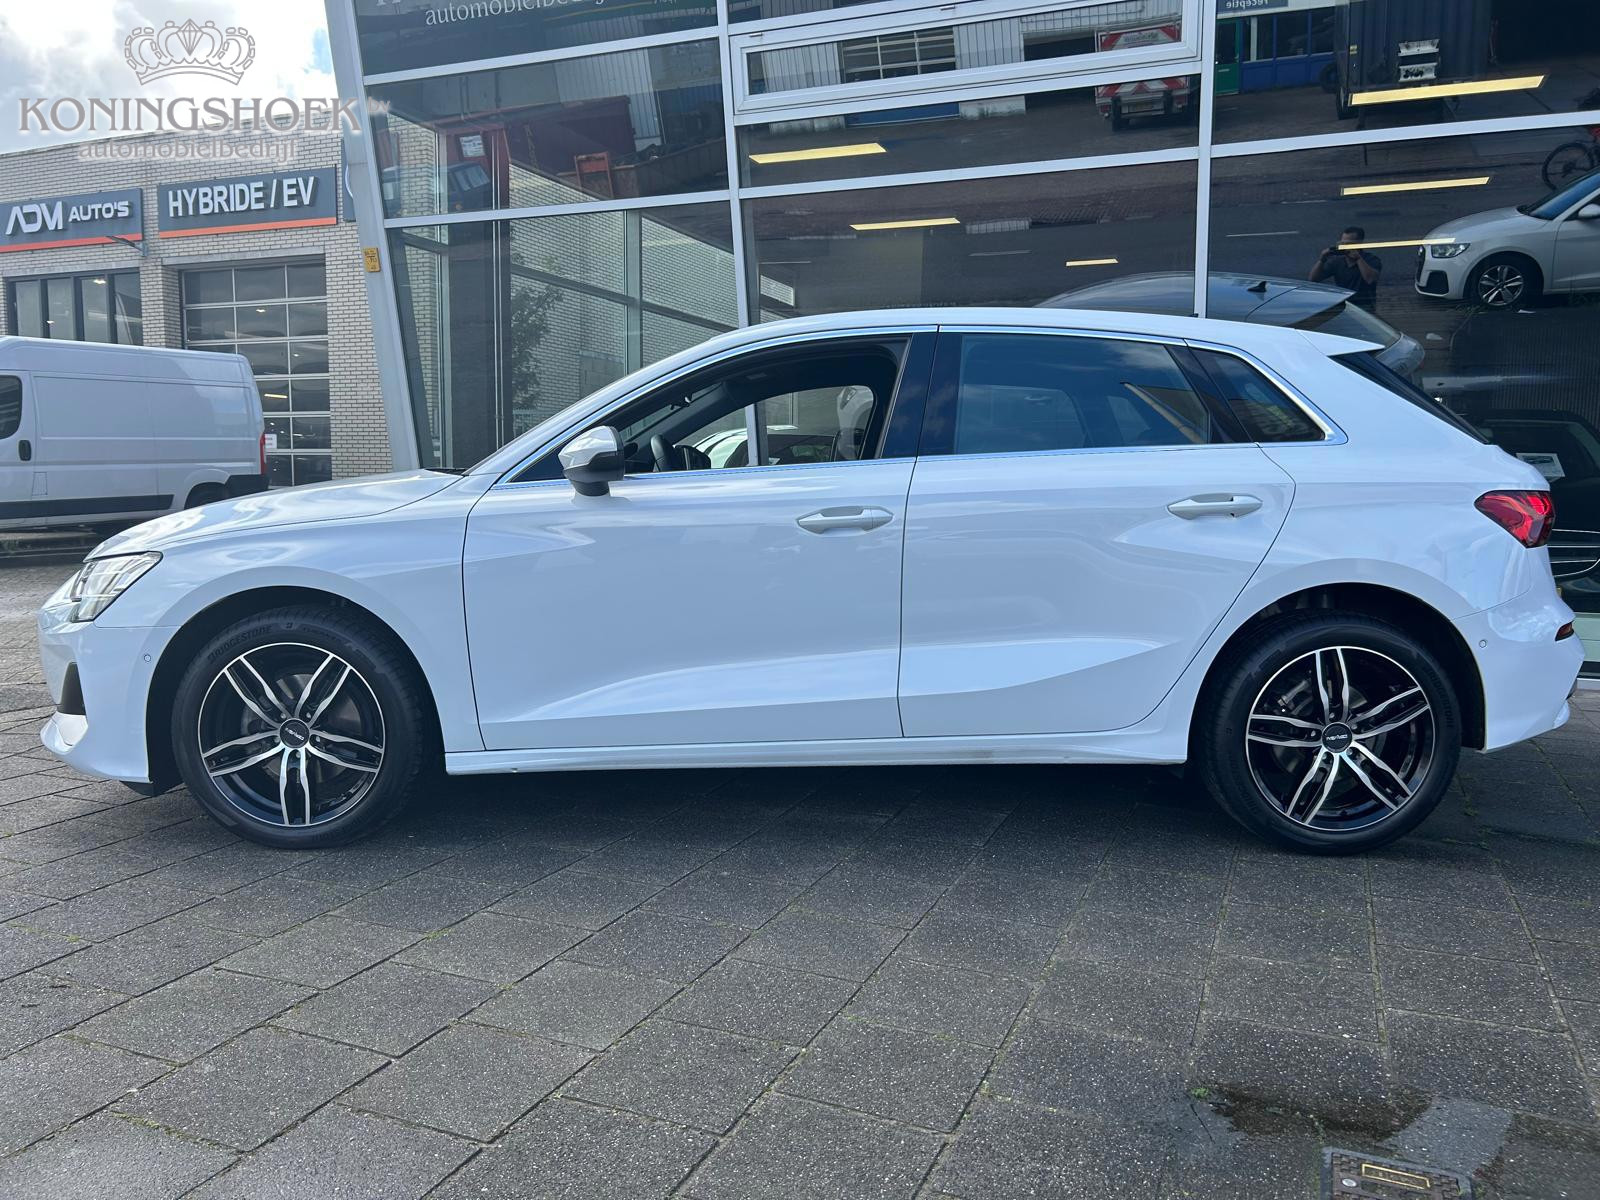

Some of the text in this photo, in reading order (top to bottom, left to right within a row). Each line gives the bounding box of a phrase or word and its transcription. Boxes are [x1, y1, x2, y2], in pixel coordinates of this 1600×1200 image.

[167, 180, 266, 218] HYBRIDE
[282, 175, 316, 208] EV
[5, 200, 130, 236] ADM AUTO'S
